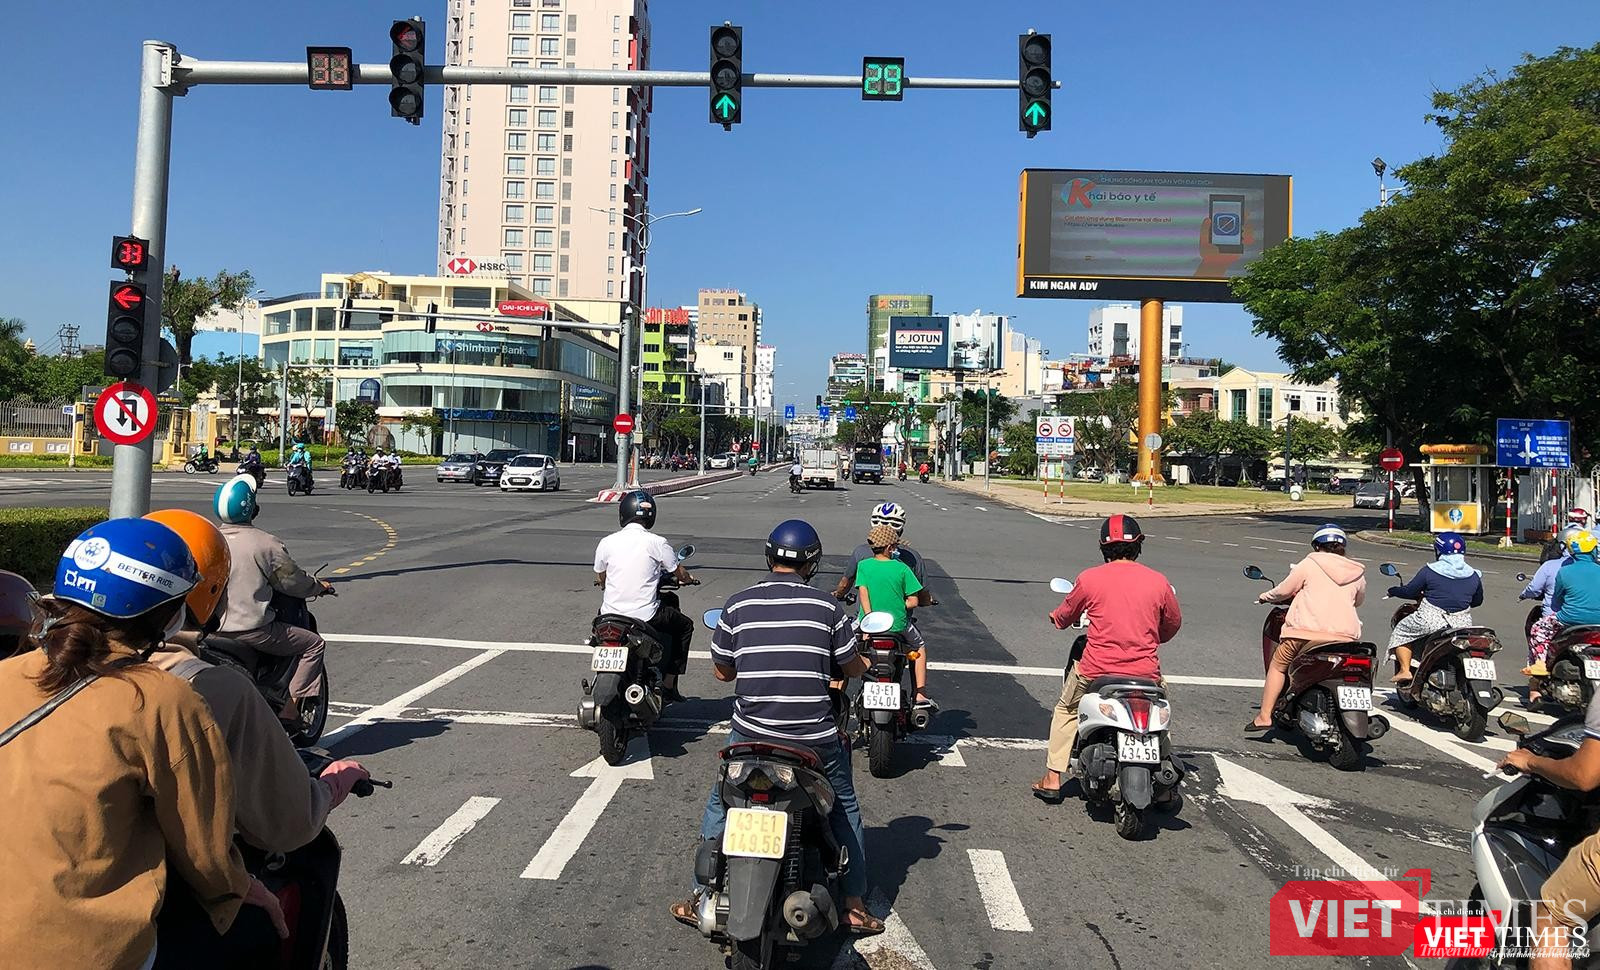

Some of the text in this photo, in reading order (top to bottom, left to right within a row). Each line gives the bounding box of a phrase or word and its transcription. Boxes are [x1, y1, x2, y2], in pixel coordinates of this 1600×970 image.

[865, 64, 901, 95] 29
[1109, 191, 1132, 201] báo
[1134, 193, 1141, 203] y
[1143, 191, 1157, 201] tế
[120, 243, 143, 265] 33
[479, 262, 506, 271] HSBC
[1030, 280, 1099, 291] KIM NGAN ADV
[908, 333, 941, 343] JOTUN
[456, 342, 526, 355] Shinhan Bank
[117, 562, 175, 589] BETTER RIDE
[77, 576, 97, 593] PTI
[598, 648, 623, 658] 43-H1
[593, 659, 625, 670] 039.02
[1466, 668, 1494, 679] 745.39
[870, 684, 893, 696] 43-E1
[1343, 688, 1366, 699] 43-E1
[866, 695, 898, 708] 554.04
[1341, 698, 1371, 709] 599.95
[1121, 747, 1158, 761] 434.56
[736, 812, 777, 833] 43-E1
[729, 832, 782, 855] 149.56
